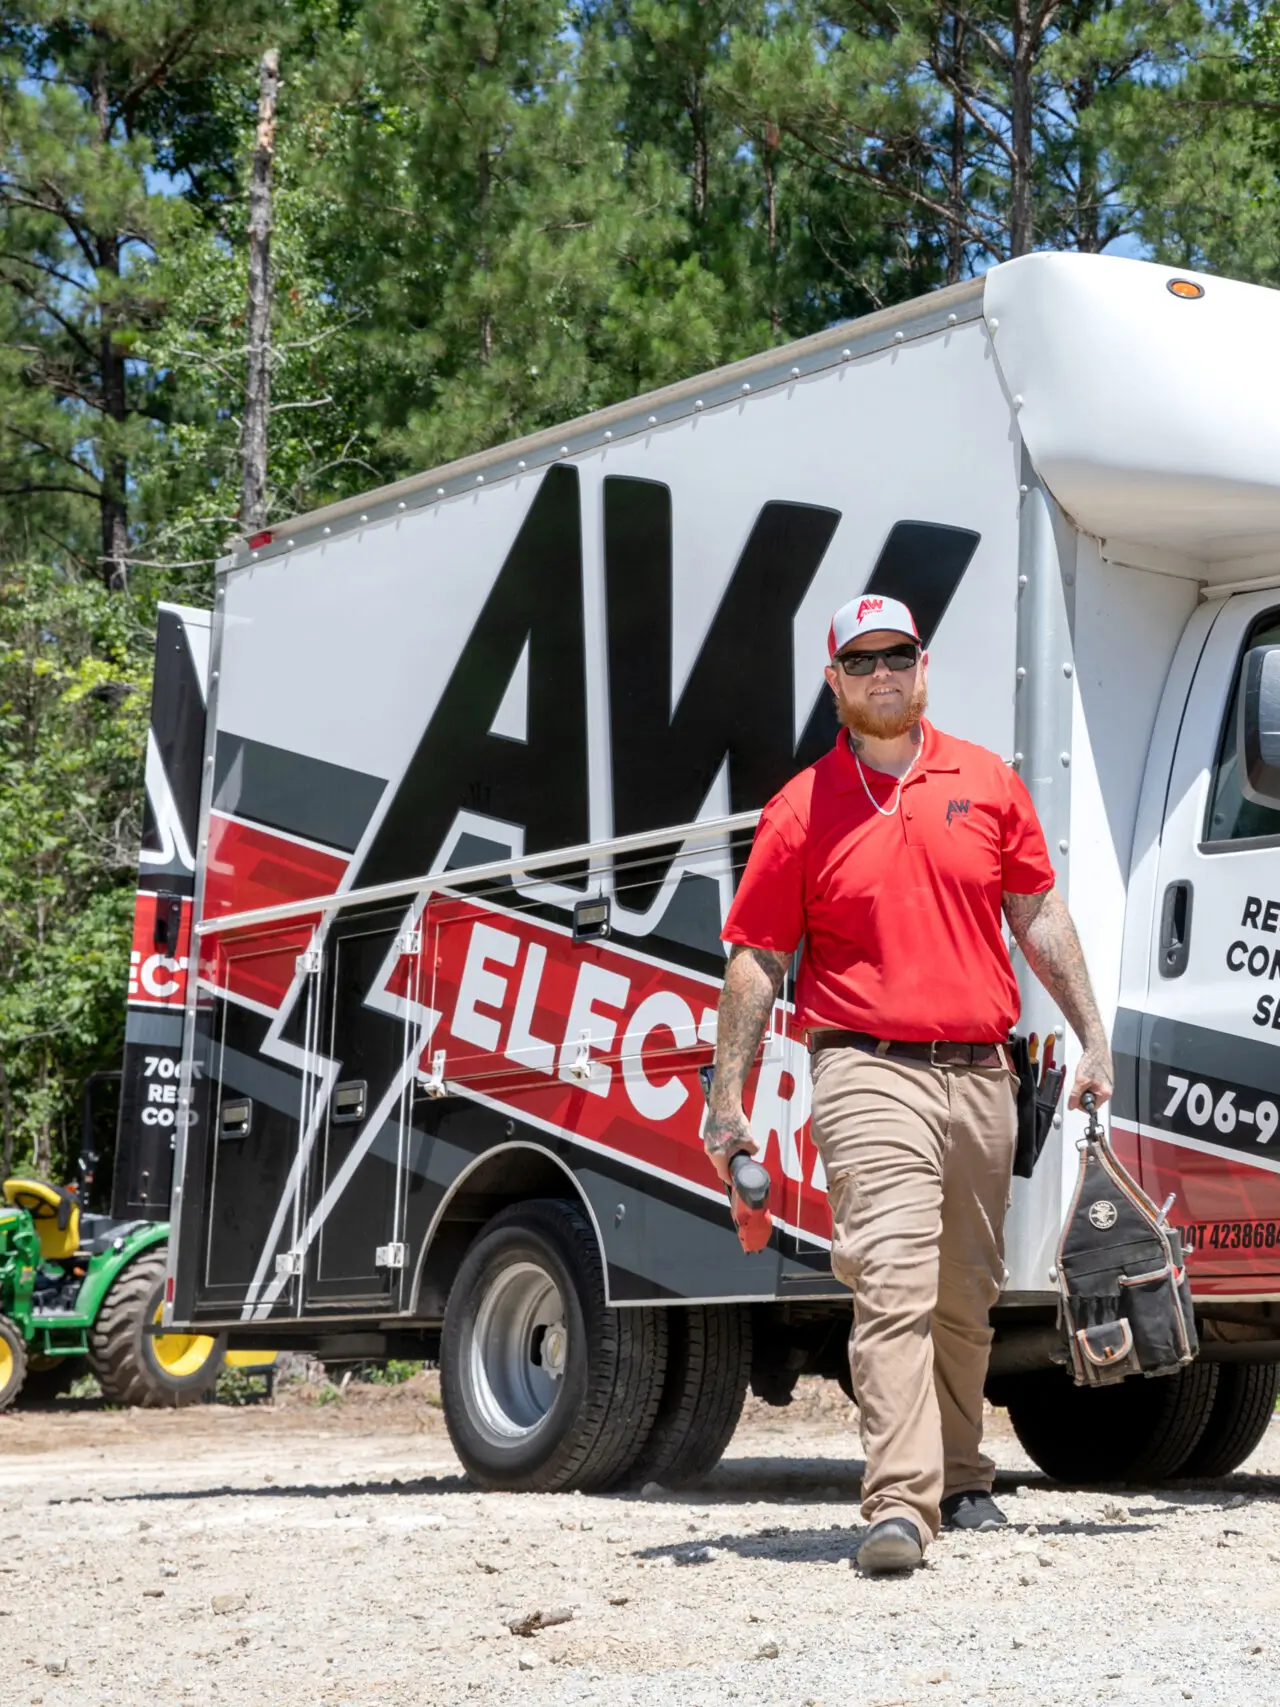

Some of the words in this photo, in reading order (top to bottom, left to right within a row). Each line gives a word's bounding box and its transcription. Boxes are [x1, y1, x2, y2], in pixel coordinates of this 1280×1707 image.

[857, 598, 884, 619] AW
[946, 799, 971, 820] AW
[448, 921, 829, 1193] ELECR
